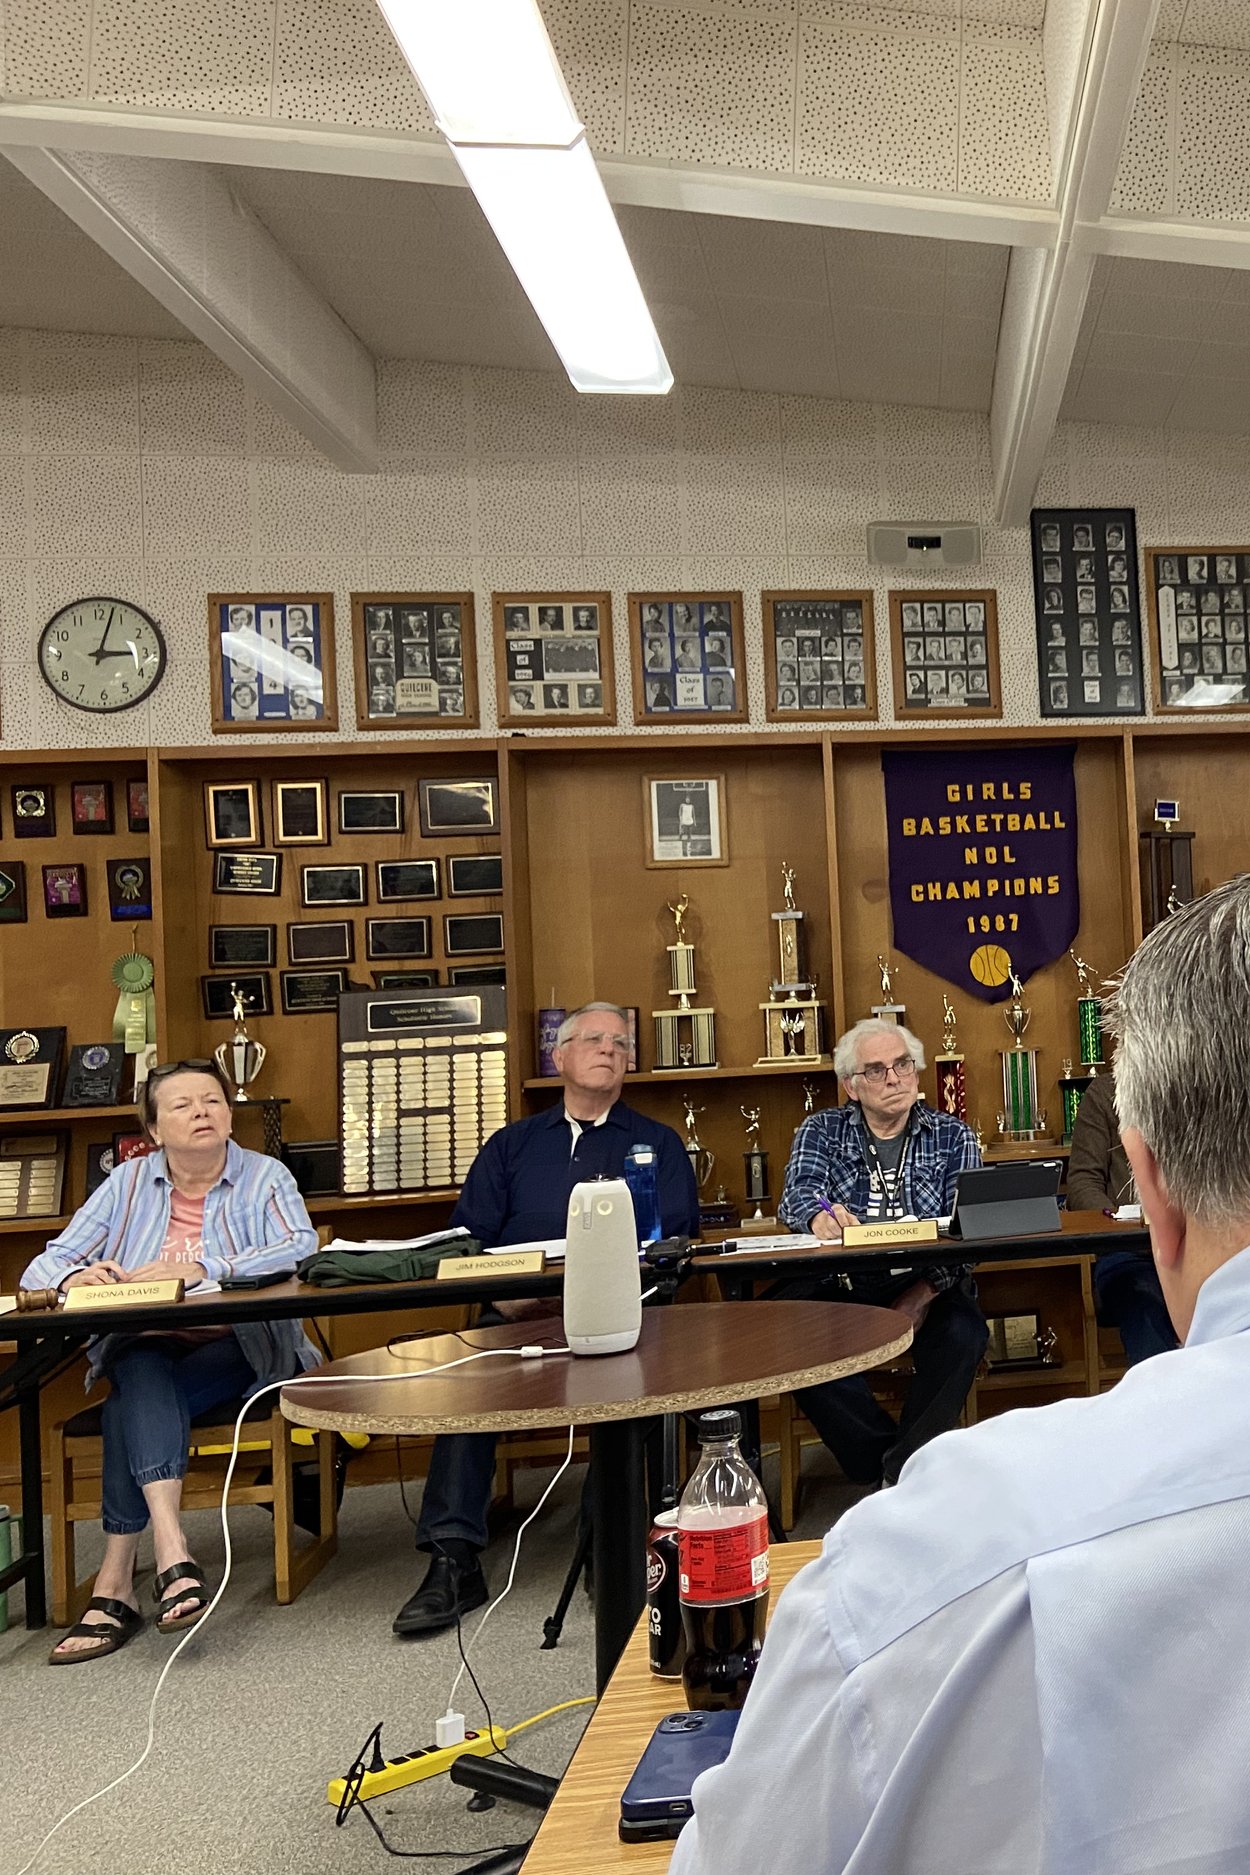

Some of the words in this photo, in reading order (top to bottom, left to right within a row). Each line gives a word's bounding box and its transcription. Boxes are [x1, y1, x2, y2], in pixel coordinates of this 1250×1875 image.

[73, 615, 83, 627] 11
[94, 609, 105, 621] 12
[119, 613, 123, 626] 1
[56, 630, 69, 642] 10
[135, 628, 142, 640] 2
[56, 650, 62, 662] 9
[142, 647, 149, 659] 3
[61, 670, 69, 682] 8
[137, 667, 144, 679] 4
[679, 676, 700, 684] Class
[78, 684, 86, 696] 7
[121, 682, 130, 694] 5
[686, 685, 696, 694] of
[100, 689, 108, 701] 6
[946, 782, 1032, 802] GIRLS
[902, 811, 1066, 836] BASKETBALL
[964, 845, 1017, 865] NOL
[910, 875, 1060, 902] CHAMPIONS
[966, 913, 1019, 934] 1987
[863, 1230, 883, 1238] JON
[885, 1227, 919, 1237] COOKE
[455, 1263, 473, 1271] JIM
[475, 1259, 526, 1269] HODGSON
[85, 1290, 125, 1299] SHONA
[127, 1287, 160, 1296] DAVIS
